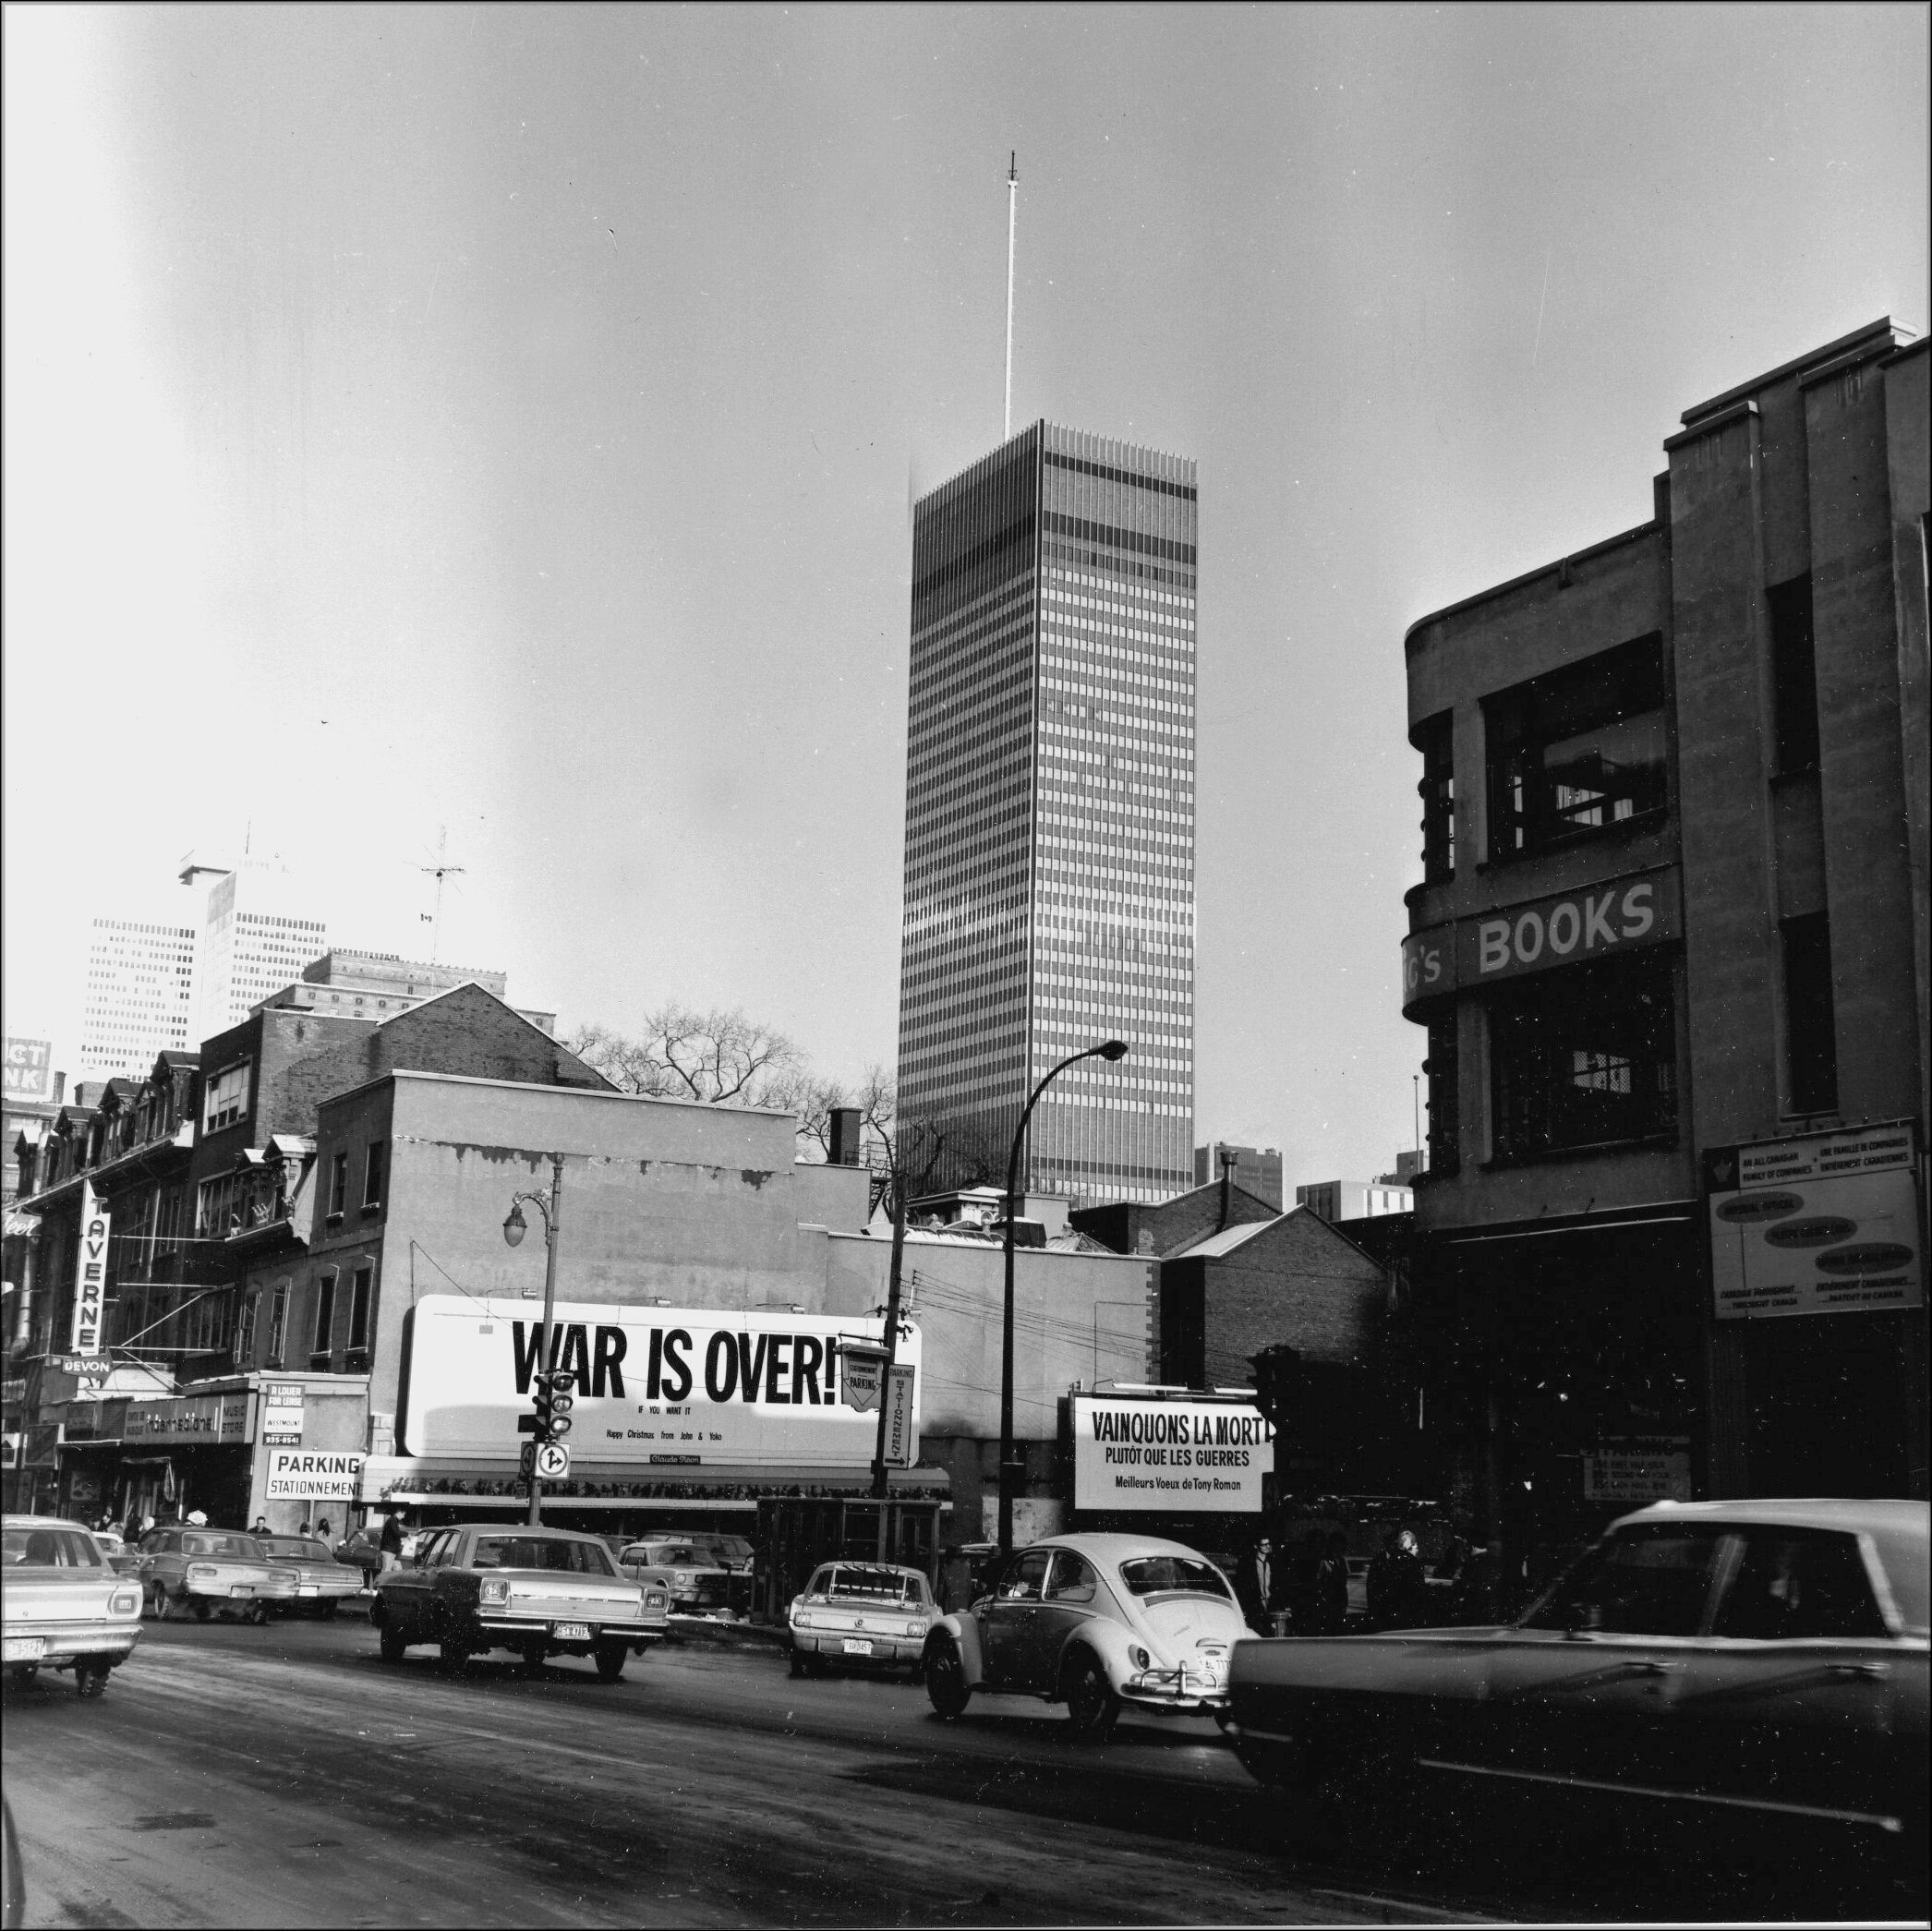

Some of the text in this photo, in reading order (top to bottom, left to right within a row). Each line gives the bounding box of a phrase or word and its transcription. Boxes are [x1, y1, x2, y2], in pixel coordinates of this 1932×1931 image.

[1479, 884, 1654, 973] BOOKS
[1833, 1143, 1859, 1155] FAMILLE
[1860, 1141, 1869, 1152] DE
[1869, 1137, 1908, 1151] COMPAGNIES
[1755, 1156, 1766, 1166] ALL
[1766, 1153, 1798, 1164] CANADIAN
[1864, 1153, 1909, 1166] CANADIENNES
[1744, 1165, 1812, 1182] FAMILY OF COMPANIES
[78, 1198, 108, 1347] TAVERNE
[1873, 1290, 1903, 1299] CANADA
[1771, 1297, 1798, 1307] CANADA
[65, 1359, 110, 1372] DEVON
[513, 1322, 837, 1405] WAR IS OVER!
[889, 1368, 913, 1378] PARKING
[850, 1376, 876, 1391] PARKING
[278, 1386, 301, 1396] LOUER
[269, 1396, 303, 1406] FOR LEASE
[223, 1405, 245, 1417] MUSIC
[638, 1406, 692, 1416] IF YOU WANT IT
[892, 1380, 904, 1457] STATIONNEMENT
[222, 1421, 243, 1433] STORE
[1093, 1411, 1189, 1445] VAINQUONS
[1194, 1416, 1213, 1445] LA
[607, 1429, 722, 1442] Happy Christmas from John & Yoko
[1105, 1445, 1250, 1467] PLUTÔT QUE LES GUERRES
[278, 1456, 360, 1474] PARKING
[271, 1480, 360, 1496] STATIONNEMENT
[1116, 1476, 1241, 1493] Meilleurs Voeux de Tony Roman
